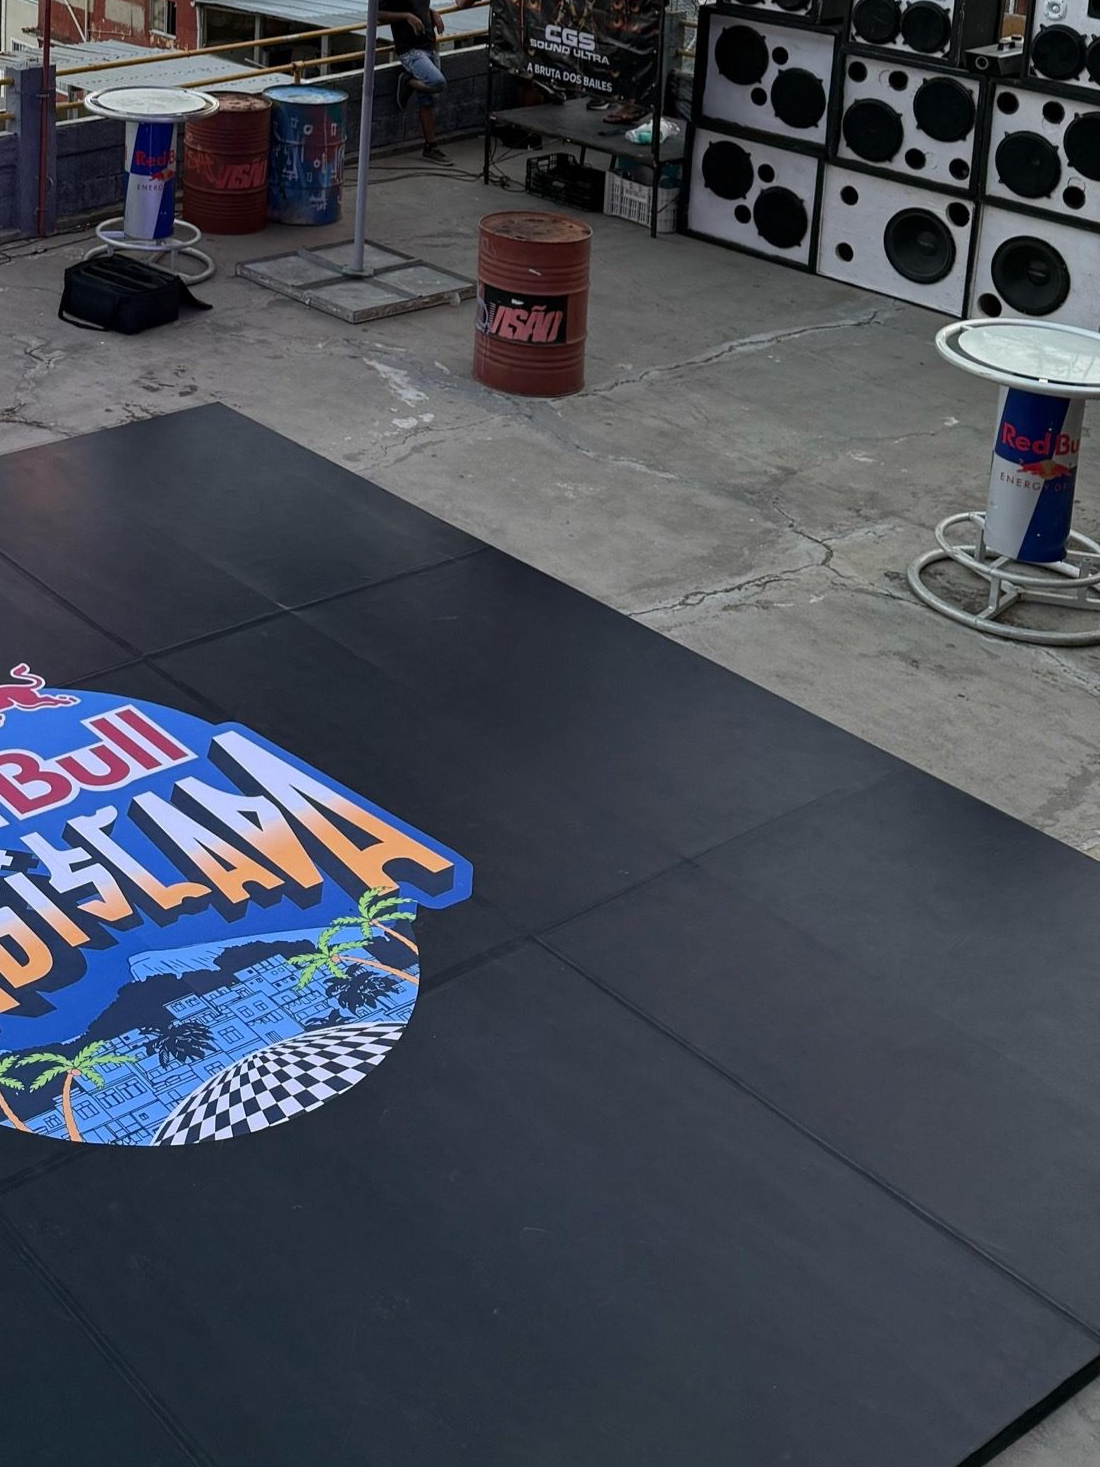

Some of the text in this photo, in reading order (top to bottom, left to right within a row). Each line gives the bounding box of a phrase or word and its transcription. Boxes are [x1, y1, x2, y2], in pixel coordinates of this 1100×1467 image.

[545, 24, 595, 51] CGS
[530, 38, 610, 66] SOUND ULTRA
[527, 62, 613, 92] A BRUTA DOS BAILES
[135, 150, 166, 166] Red
[1002, 422, 1052, 455] Red
